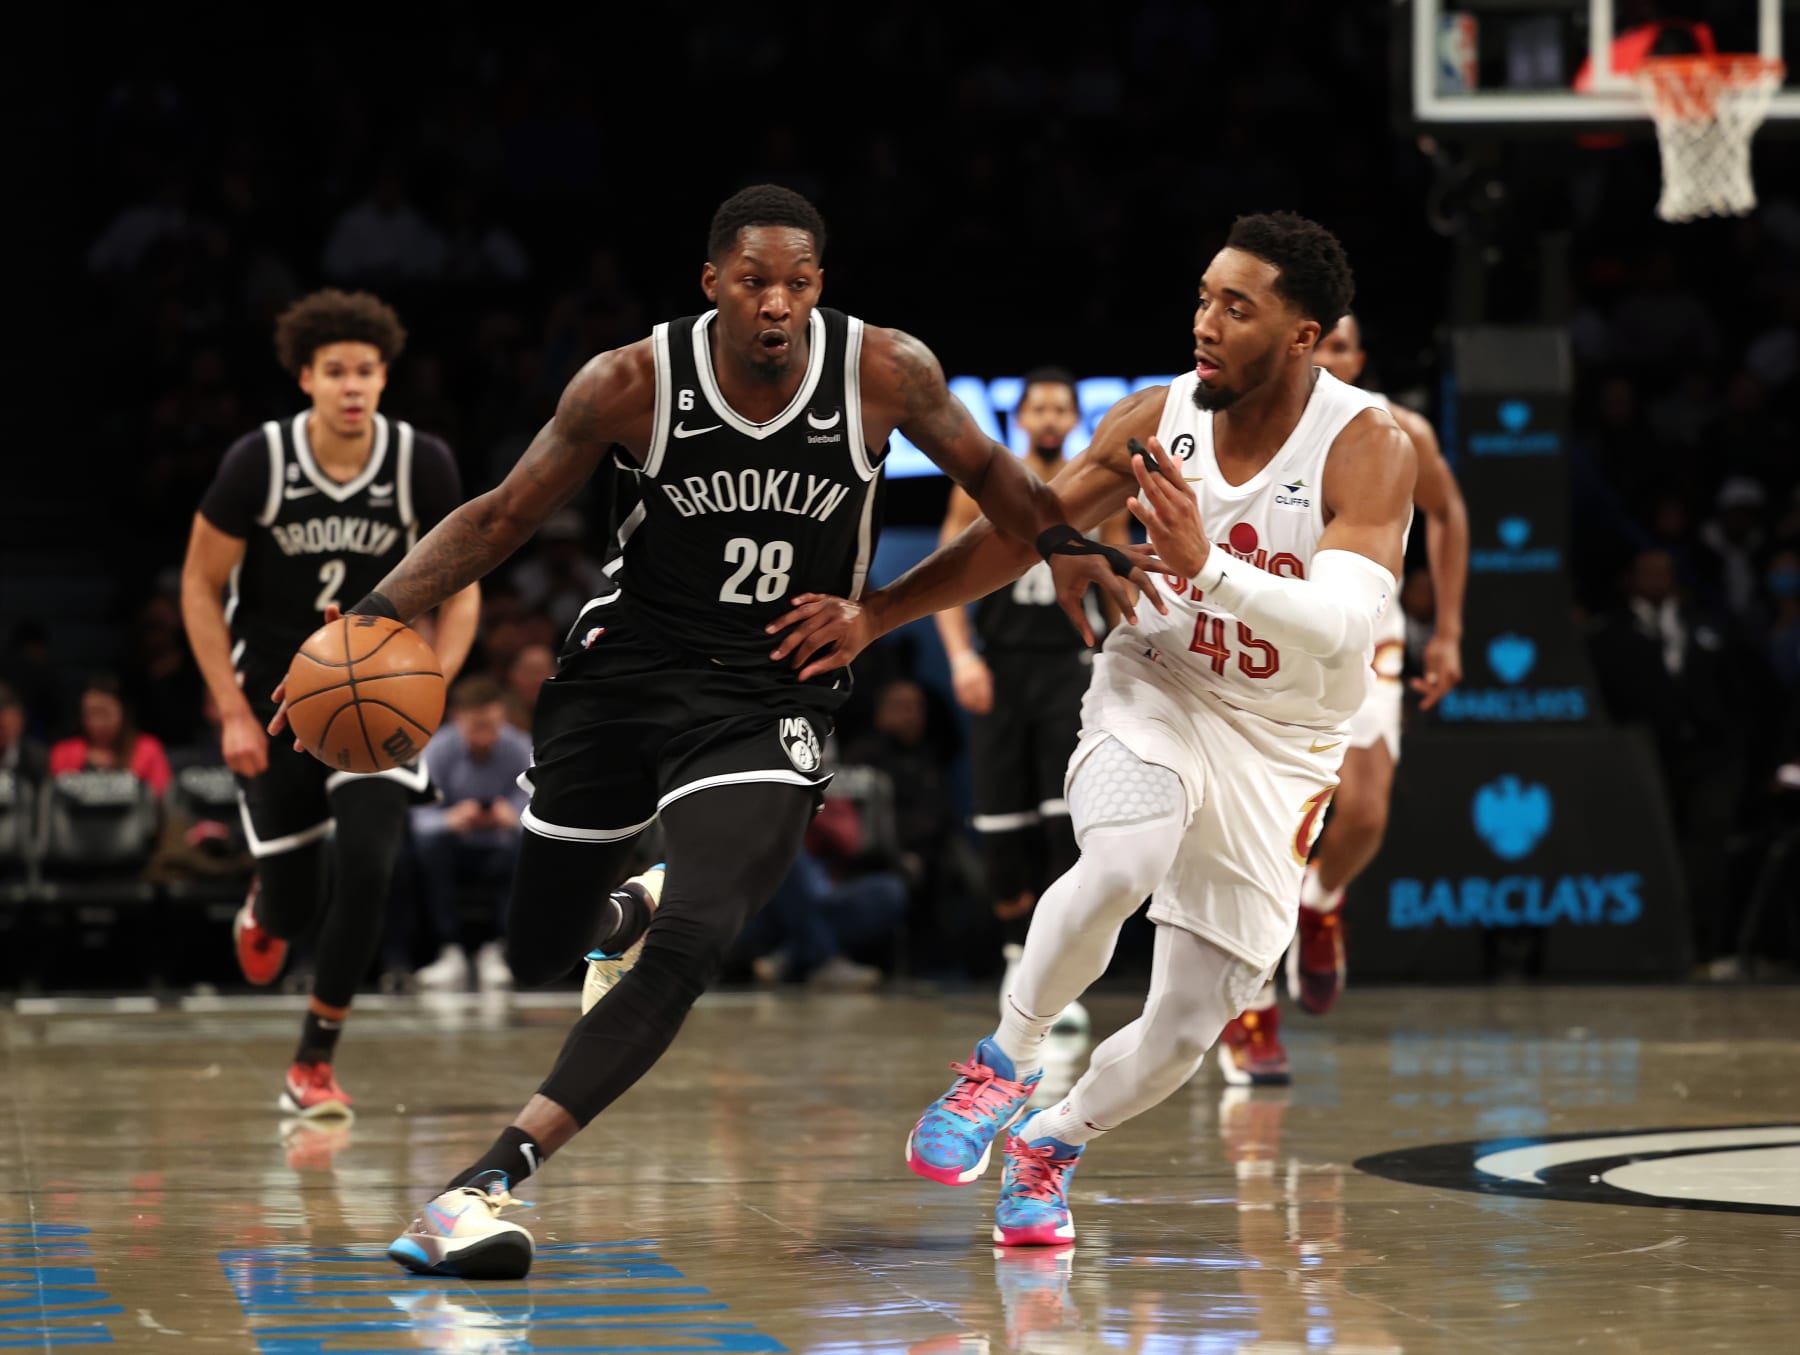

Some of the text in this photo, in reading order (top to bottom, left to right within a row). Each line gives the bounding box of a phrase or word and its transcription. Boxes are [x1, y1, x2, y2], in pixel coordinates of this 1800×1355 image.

[678, 389, 695, 411] 6
[1174, 437, 1195, 461] 6
[661, 468, 851, 522] BROOKLYN
[1274, 495, 1311, 508] CLIFFS
[272, 516, 399, 556] BROOKLYN
[314, 560, 346, 612] 2
[719, 537, 794, 605] 28
[1188, 611, 1280, 679] 45
[1388, 872, 1643, 929] BARCLAYS
